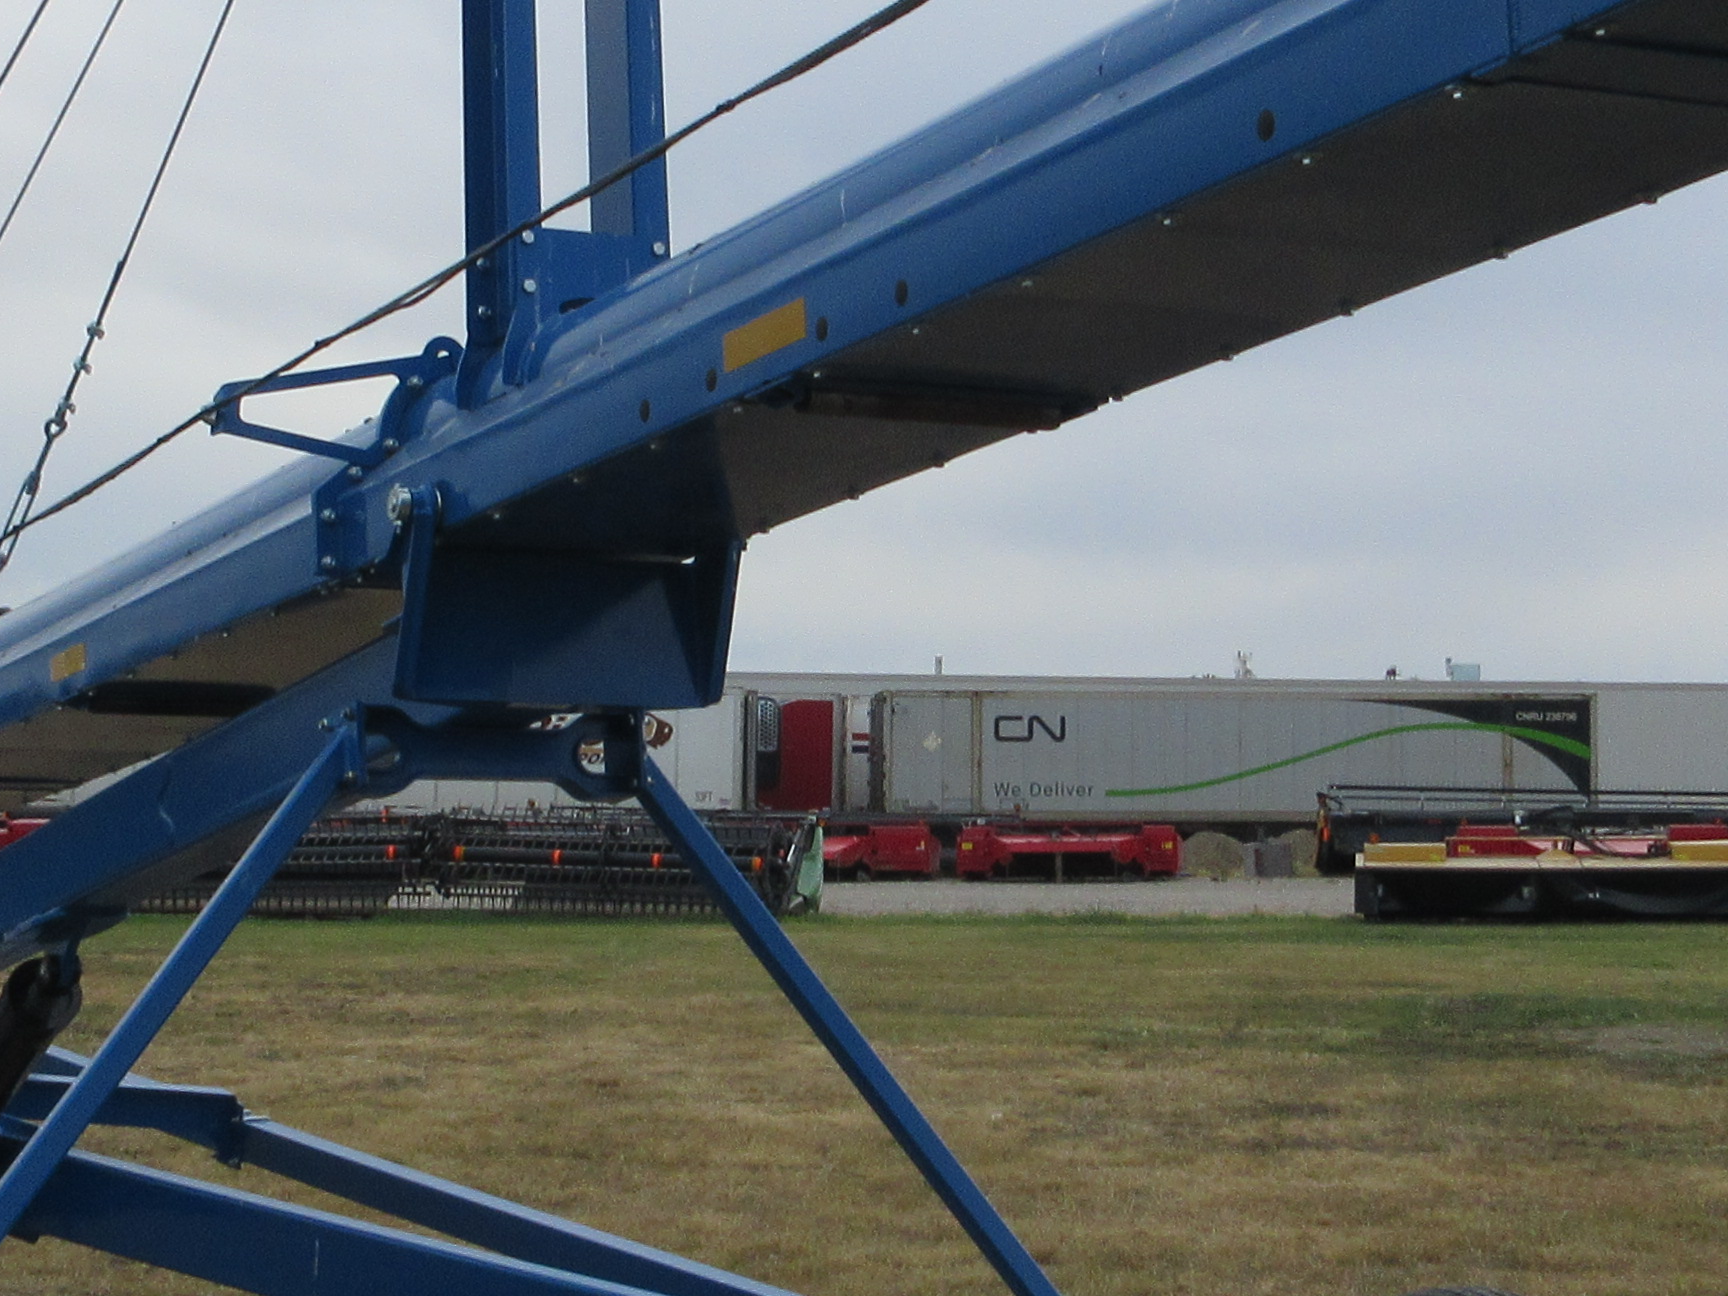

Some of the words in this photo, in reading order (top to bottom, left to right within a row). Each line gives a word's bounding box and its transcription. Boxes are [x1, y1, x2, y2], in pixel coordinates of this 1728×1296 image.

[994, 715, 1066, 742] CN
[994, 782, 1021, 797] We
[1029, 781, 1094, 797] Deliver
